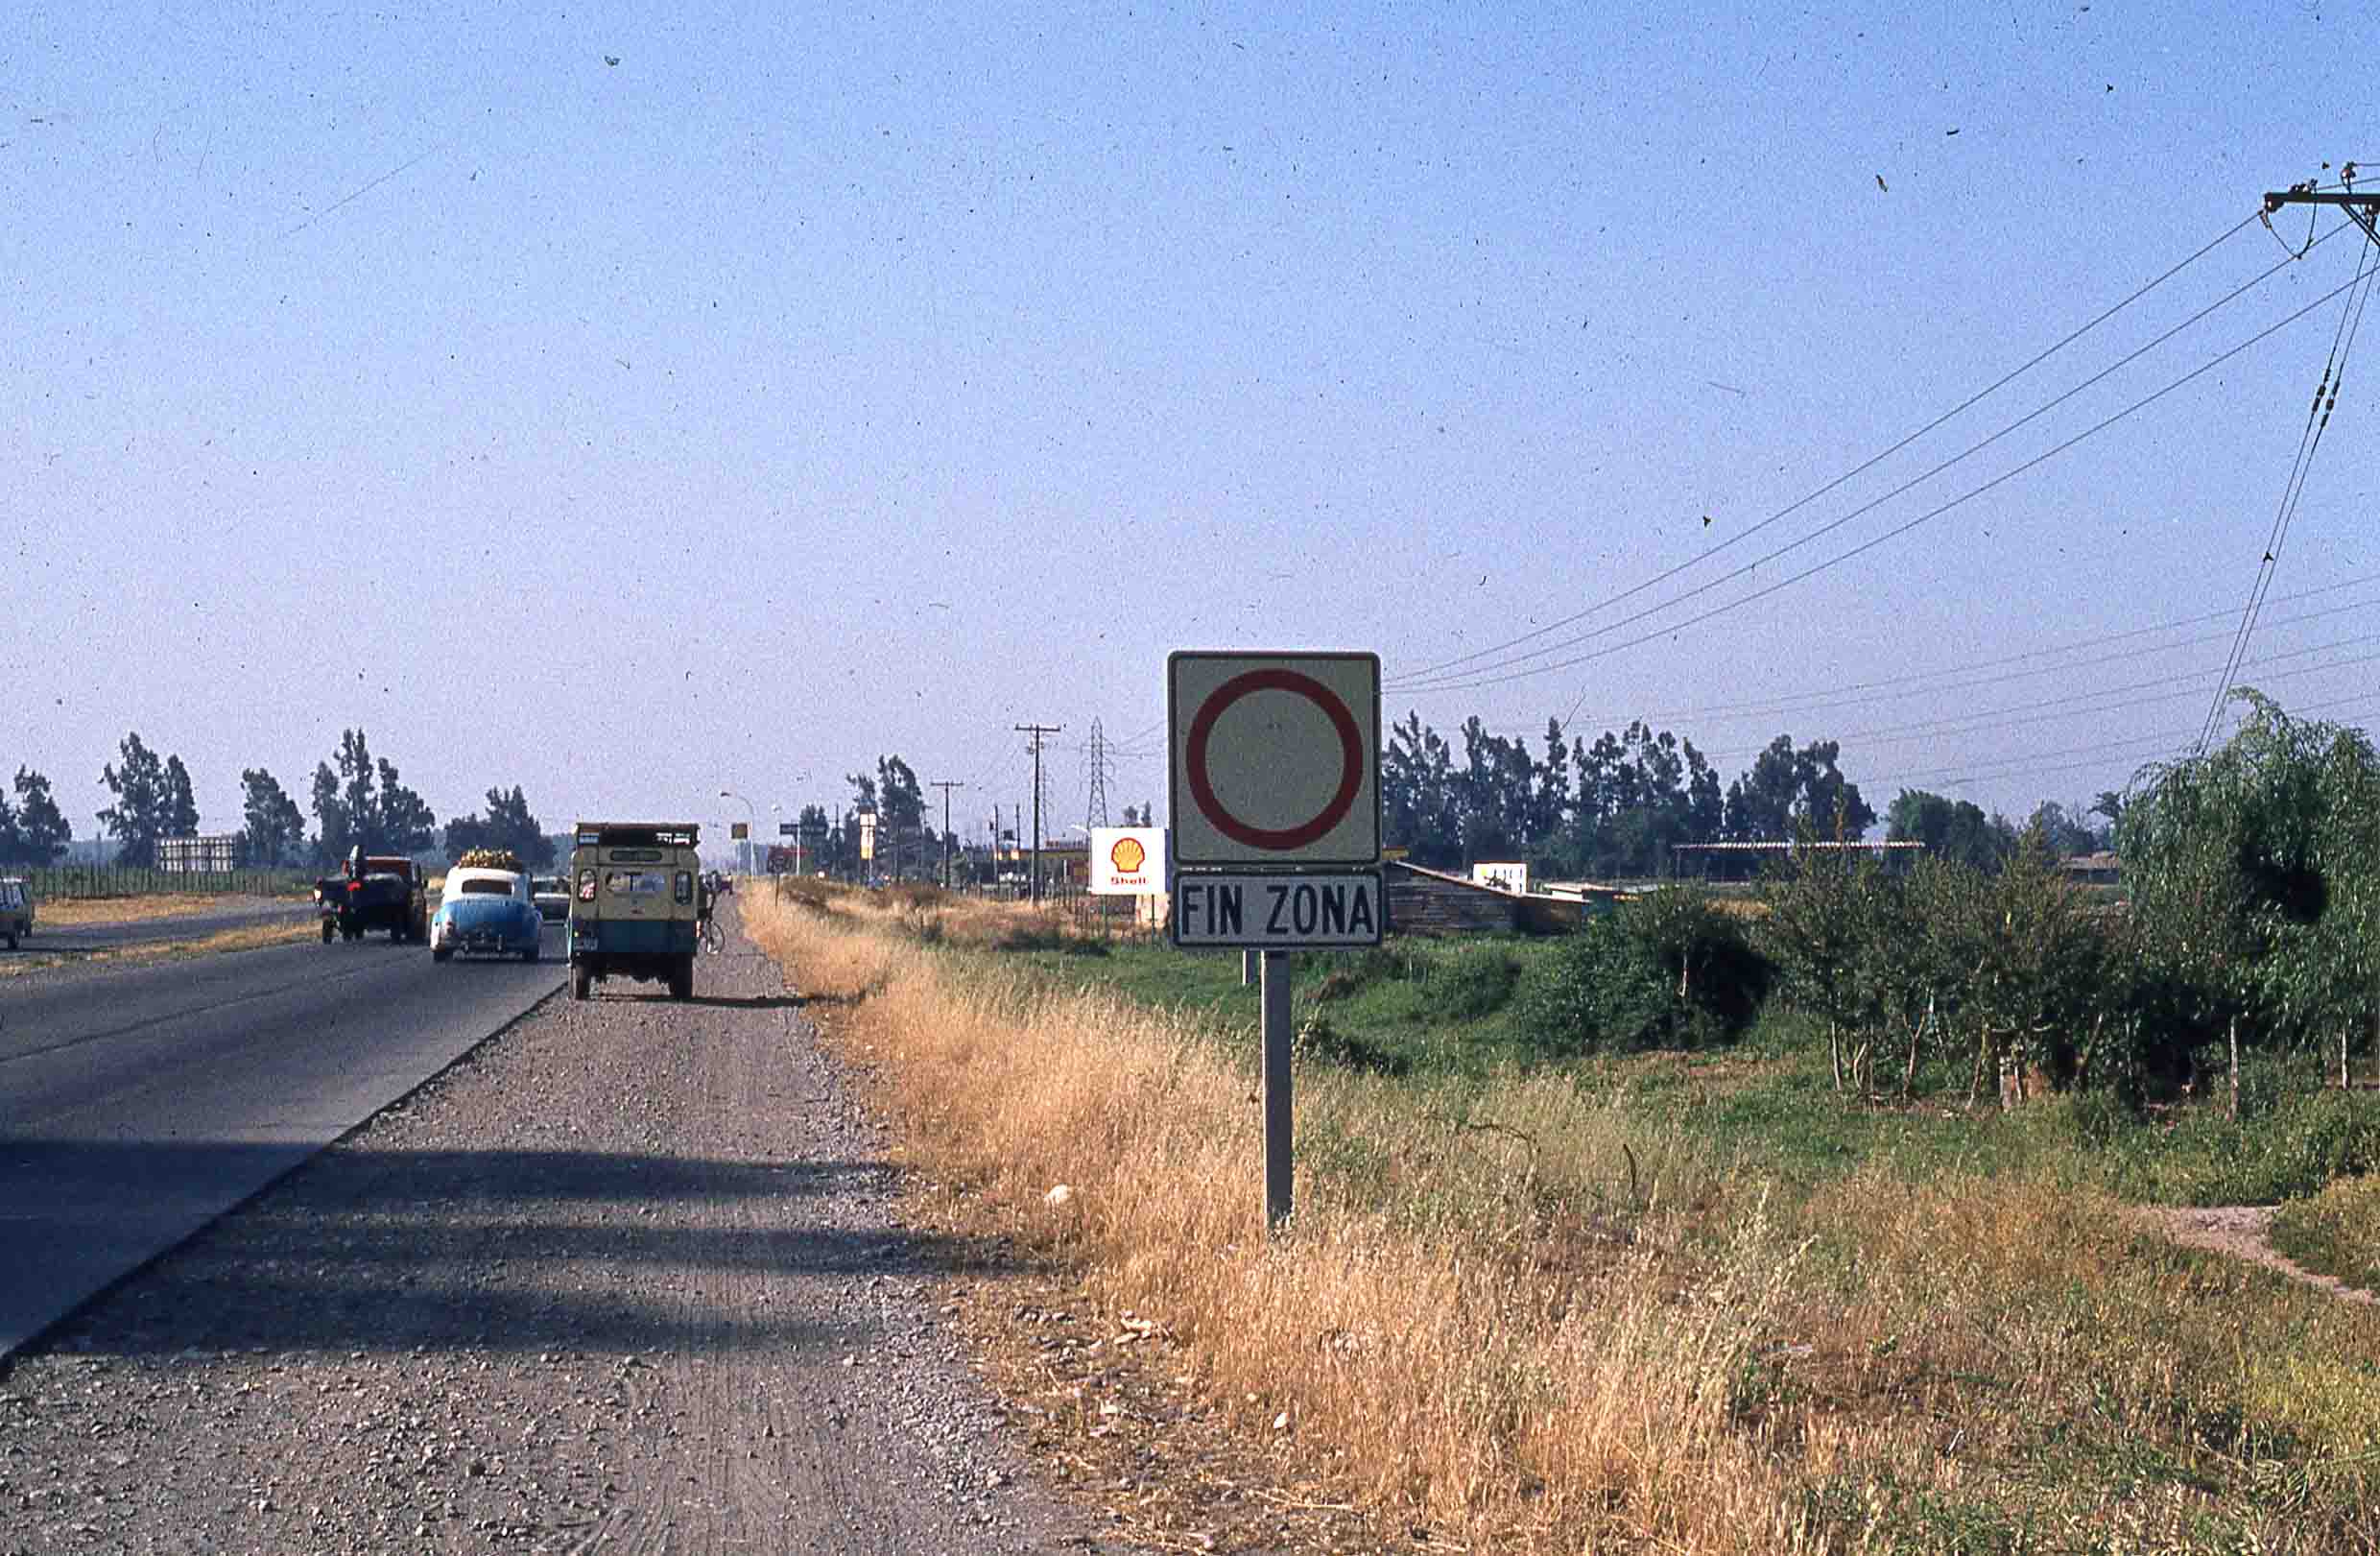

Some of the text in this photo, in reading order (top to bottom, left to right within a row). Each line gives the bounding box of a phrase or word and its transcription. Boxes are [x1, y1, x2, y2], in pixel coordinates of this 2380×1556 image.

[1110, 876, 1147, 885] Shell
[1181, 884, 1374, 935] FIN ZONA
